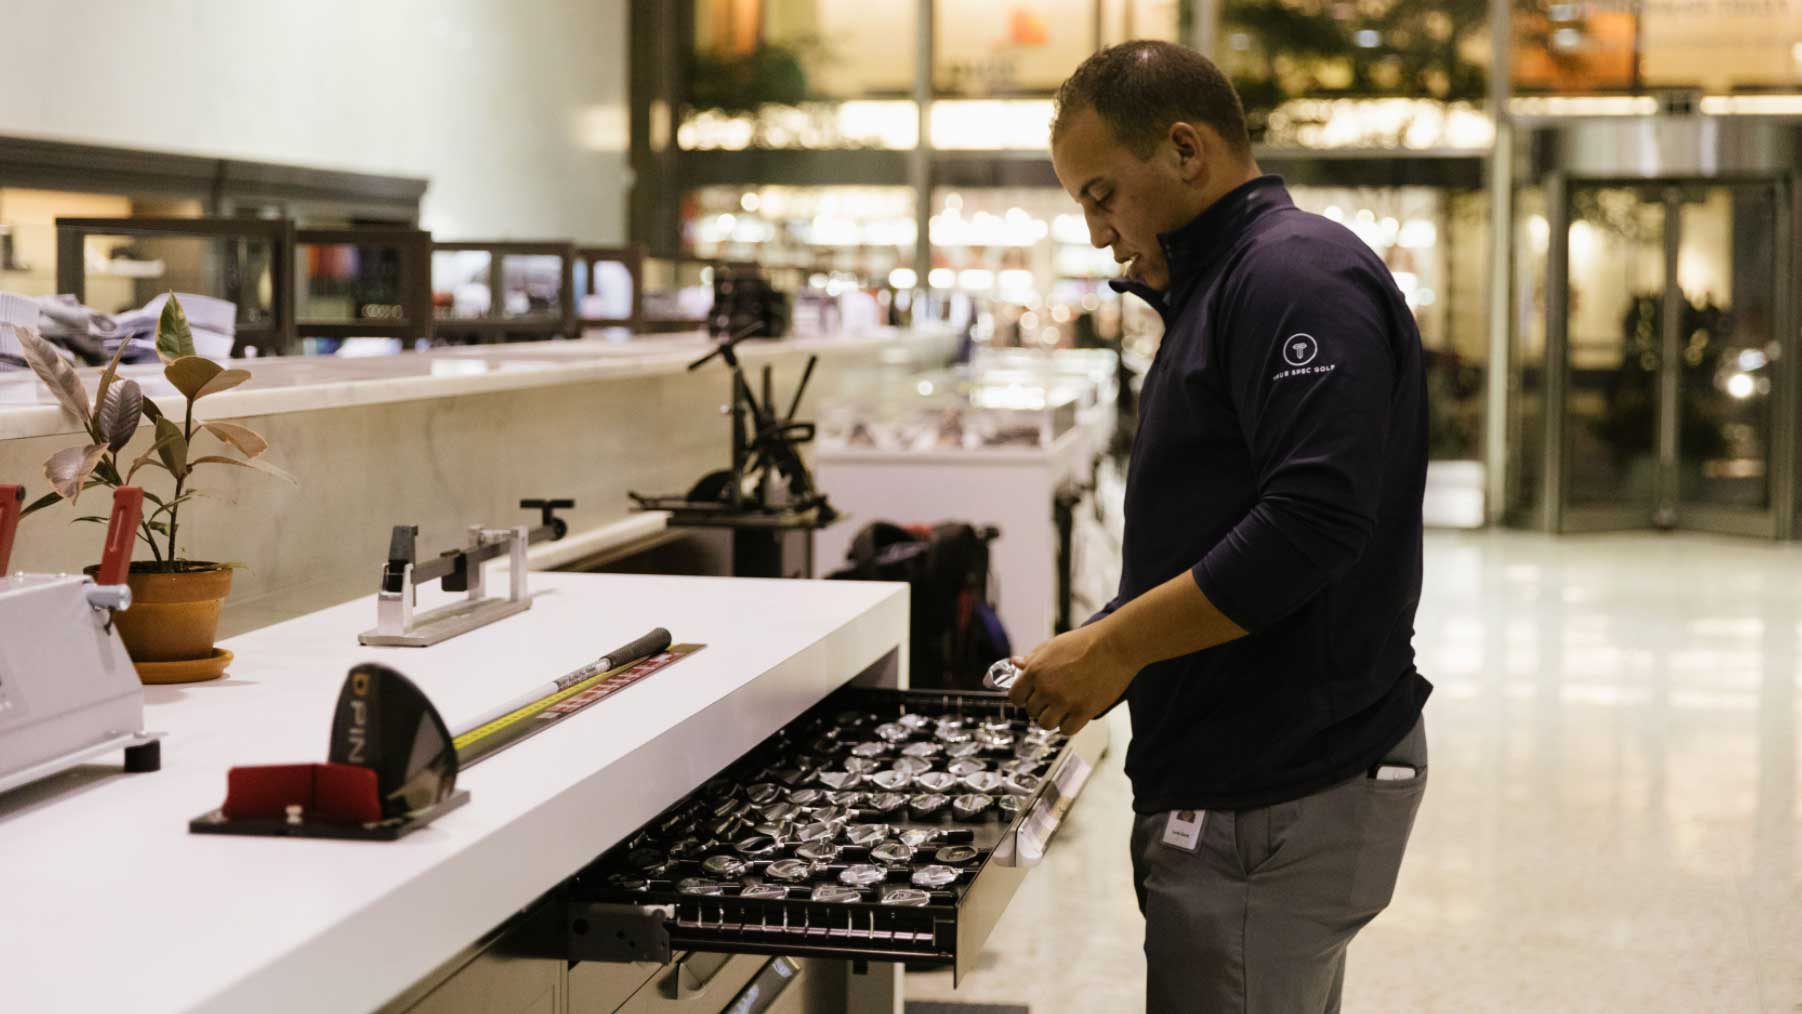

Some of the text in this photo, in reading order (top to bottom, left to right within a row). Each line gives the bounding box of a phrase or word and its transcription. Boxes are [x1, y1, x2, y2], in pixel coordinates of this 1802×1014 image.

[1291, 367, 1312, 376] SPEC
[1313, 364, 1335, 373] GOLF
[348, 701, 368, 763] PIN
